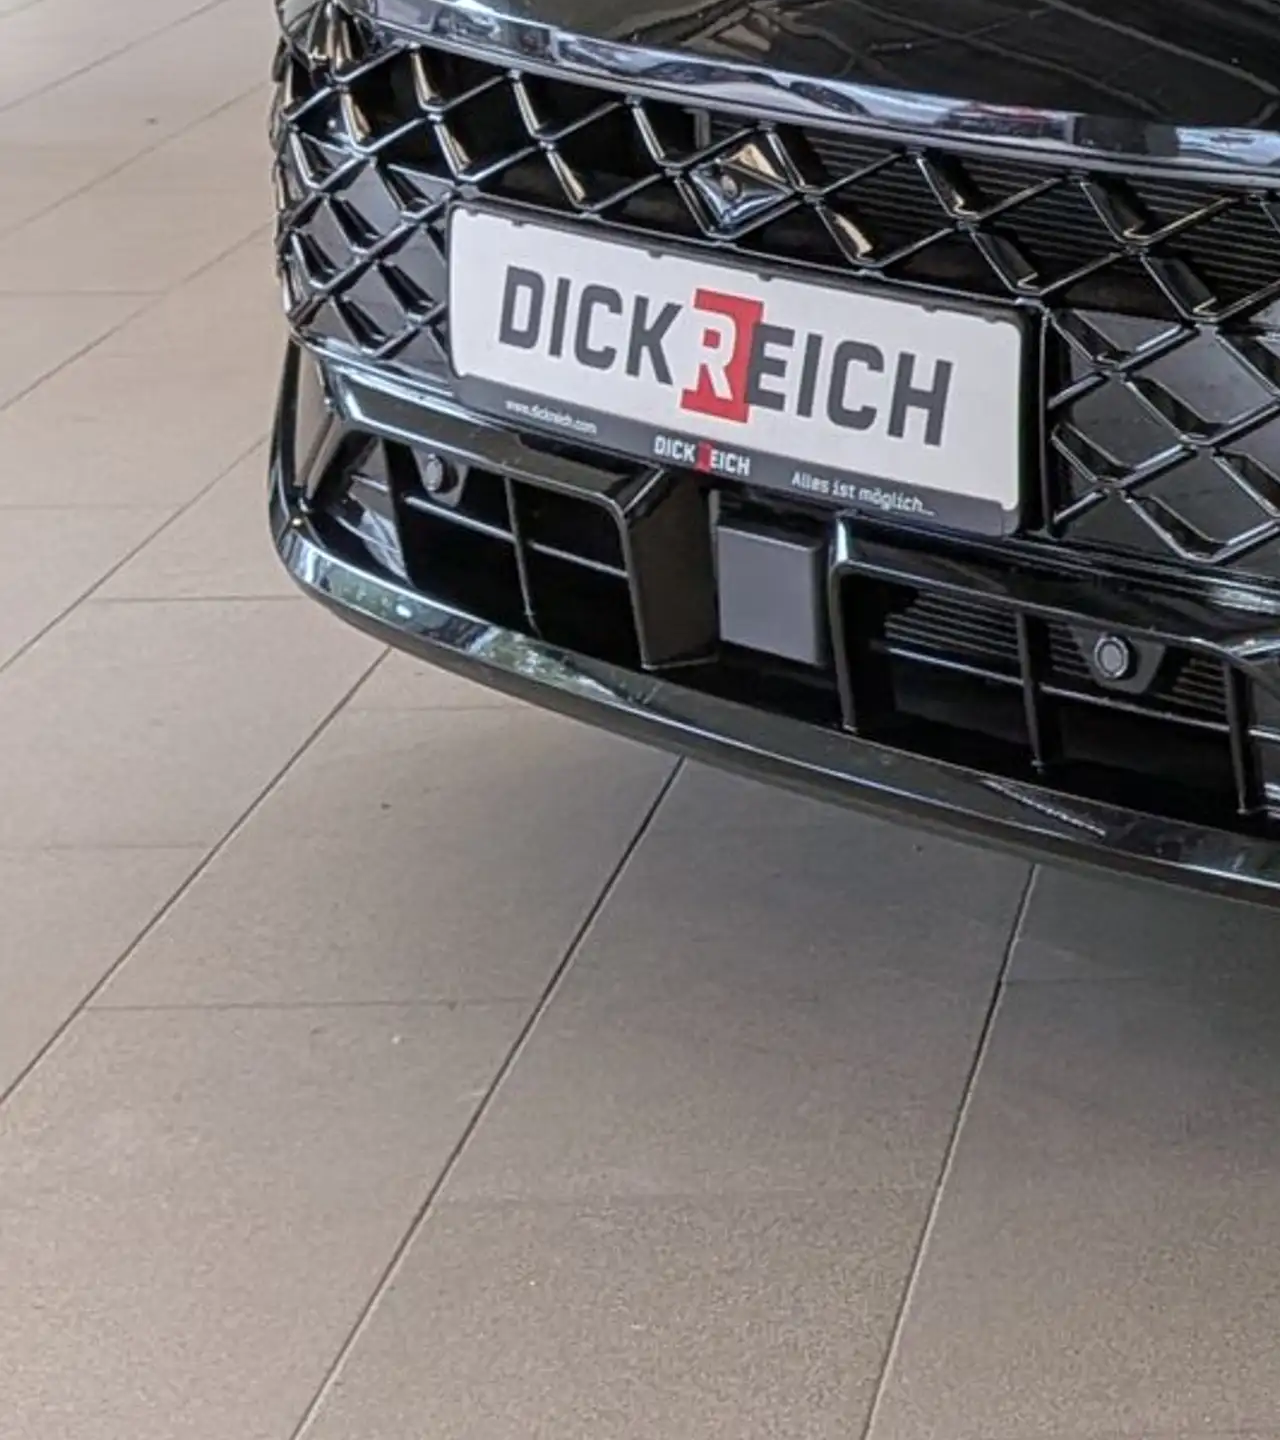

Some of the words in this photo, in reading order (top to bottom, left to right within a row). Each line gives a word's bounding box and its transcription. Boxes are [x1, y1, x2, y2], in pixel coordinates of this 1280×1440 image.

[499, 265, 954, 448] DICKREICH
[791, 471, 830, 494] Alles
[833, 479, 856, 499] ist
